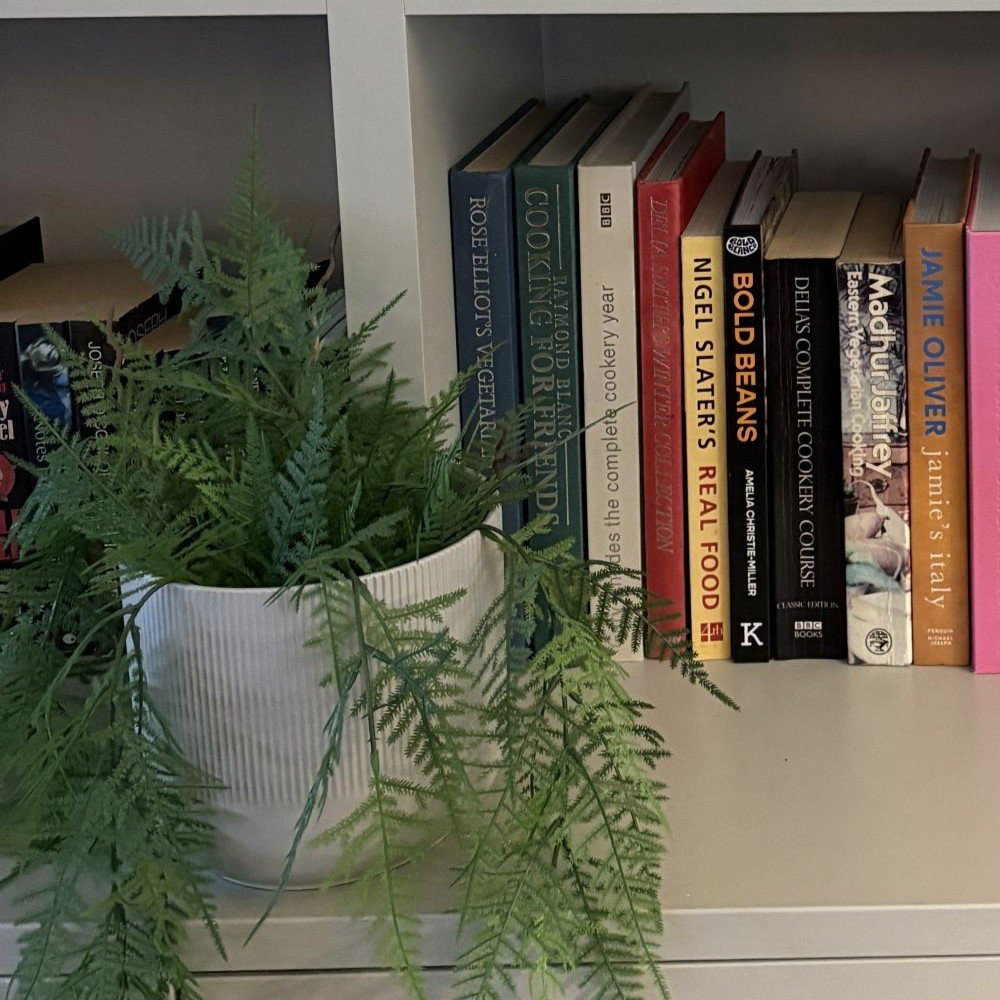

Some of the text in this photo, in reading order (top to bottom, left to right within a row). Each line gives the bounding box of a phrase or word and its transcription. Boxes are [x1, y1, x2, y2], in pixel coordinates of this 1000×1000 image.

[468, 195, 490, 249] ROSE
[524, 188, 555, 393] COOKING FOR
[732, 272, 756, 347] BOLD
[920, 246, 945, 328] JAMIE
[551, 273, 573, 442] RAYMOND BLANC
[599, 284, 622, 526] the cookery year
[734, 352, 759, 444] BEANS
[846, 269, 867, 478] Eastern Cooking
[863, 270, 897, 480] Madhur Jaffrey
[921, 335, 948, 437] OLIVER
[692, 257, 721, 611] NIGEL SLATER'S REAL FOOD
[793, 275, 816, 588] DELIA'S COMPLETE COOKERY COURSE
[744, 468, 756, 508] AMELIA
[920, 445, 951, 541] jamie's
[794, 621, 823, 630] BBC
[924, 550, 953, 610] italy
[794, 631, 824, 639] BOOKS
